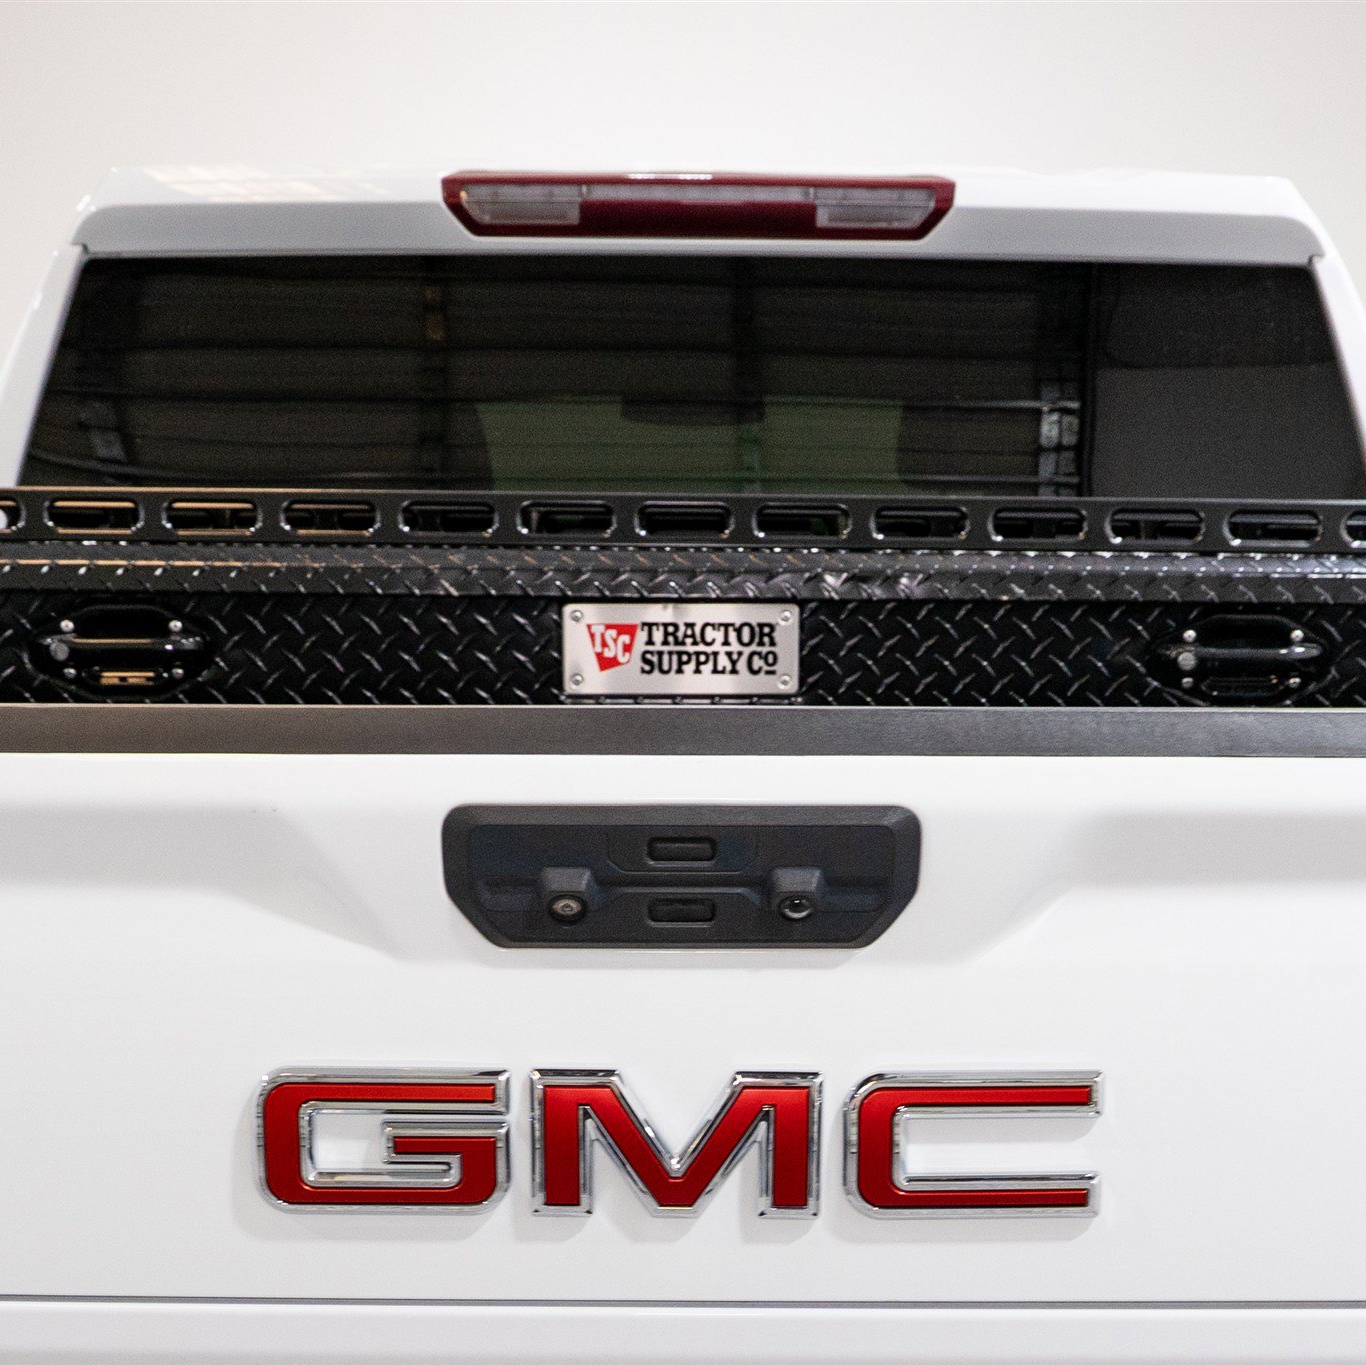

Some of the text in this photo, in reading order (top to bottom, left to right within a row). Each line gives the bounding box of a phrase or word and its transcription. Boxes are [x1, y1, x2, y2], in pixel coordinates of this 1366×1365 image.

[590, 623, 631, 664] TSC
[641, 622, 777, 647] TRACTOR
[640, 650, 743, 675] SUPPLY
[259, 1066, 1104, 1218] GMC
